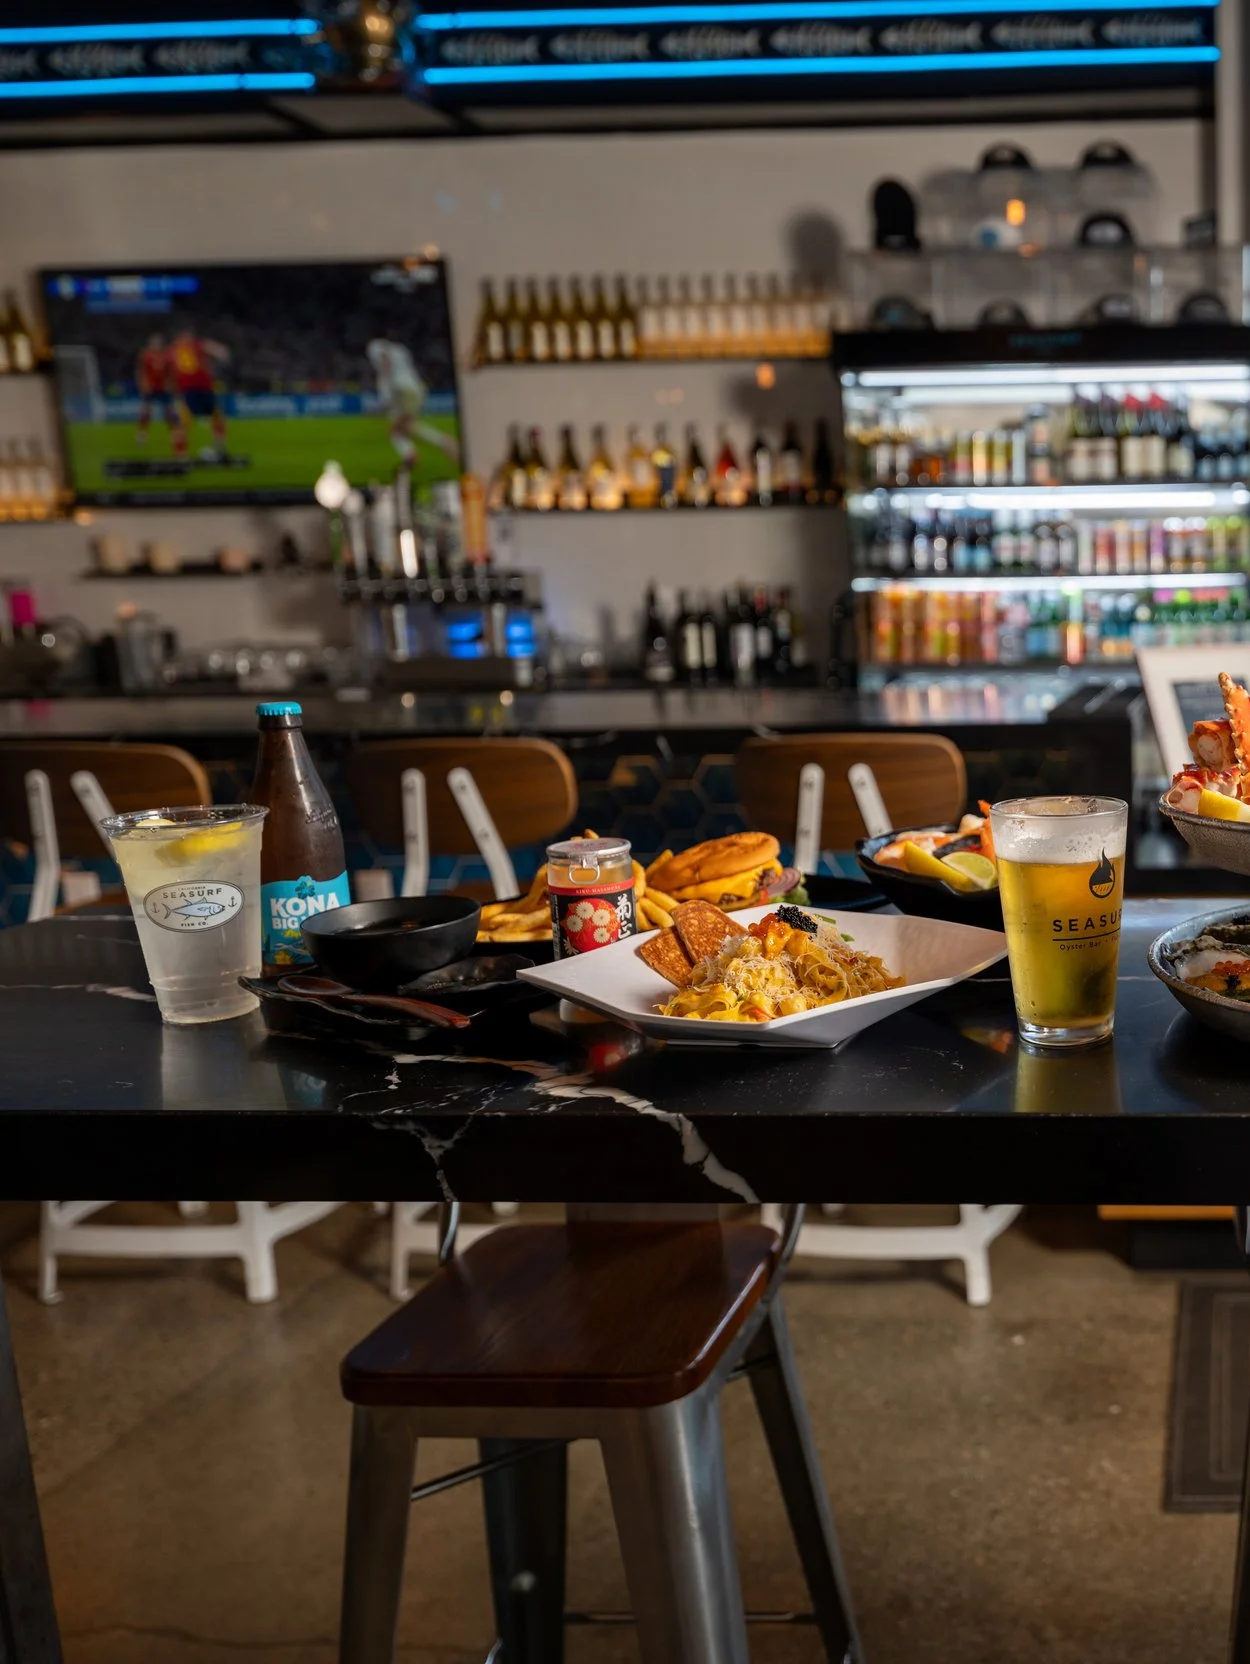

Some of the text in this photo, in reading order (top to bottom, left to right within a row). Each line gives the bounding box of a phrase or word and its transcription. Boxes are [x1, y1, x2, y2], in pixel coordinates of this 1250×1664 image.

[163, 888, 222, 899] SEASURF
[270, 892, 340, 918] KONA
[272, 916, 299, 929] BIG
[1060, 943, 1086, 951] Oyster
